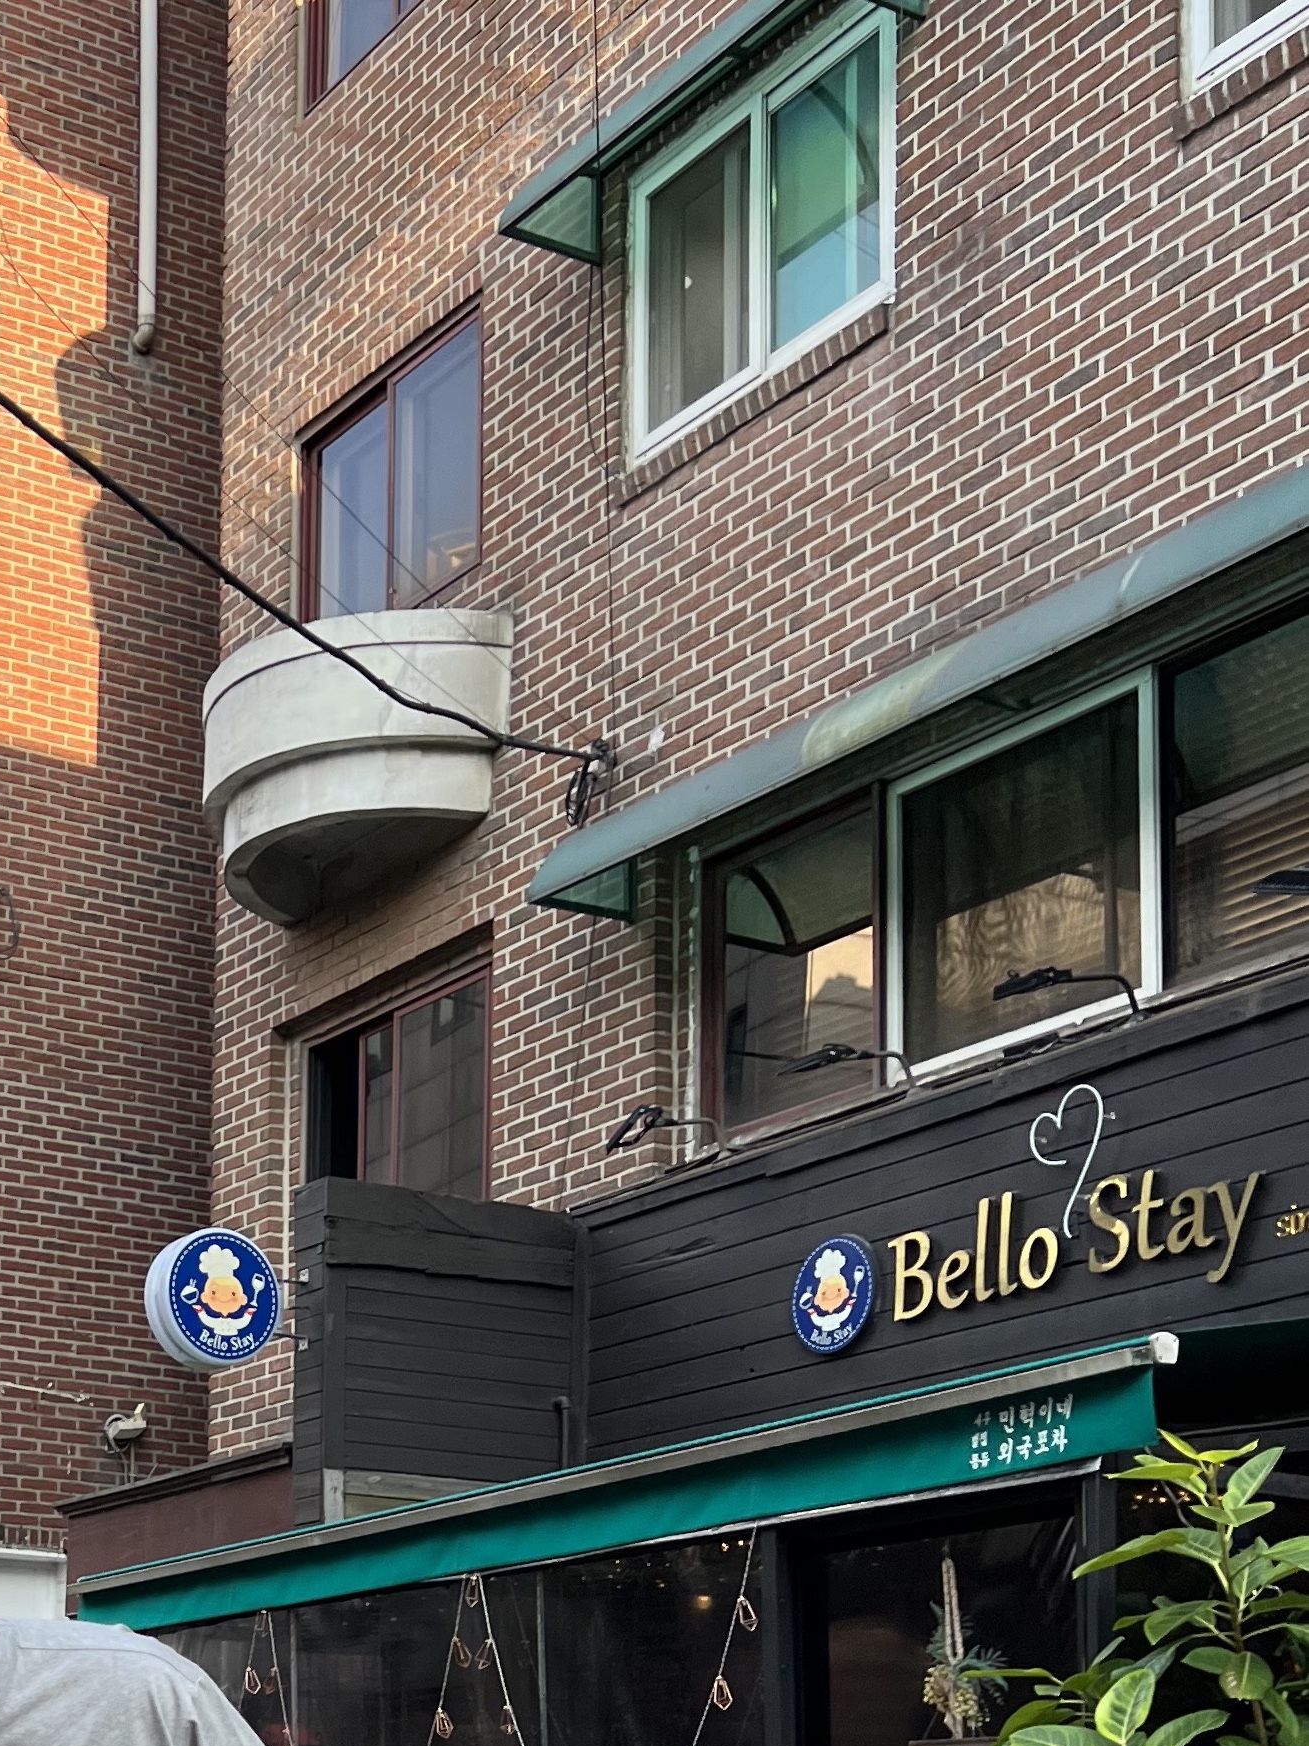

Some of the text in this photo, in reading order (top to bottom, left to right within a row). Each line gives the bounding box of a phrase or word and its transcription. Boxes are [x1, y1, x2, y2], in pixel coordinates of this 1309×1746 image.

[887, 1191, 1059, 1321] Bello
[1089, 1169, 1266, 1283] Stay
[199, 1329, 255, 1351] Bello Stay
[810, 1323, 853, 1345] Bello Stay
[998, 1393, 1073, 1433] 민혁이네
[997, 1424, 1068, 1464] 외국포차
